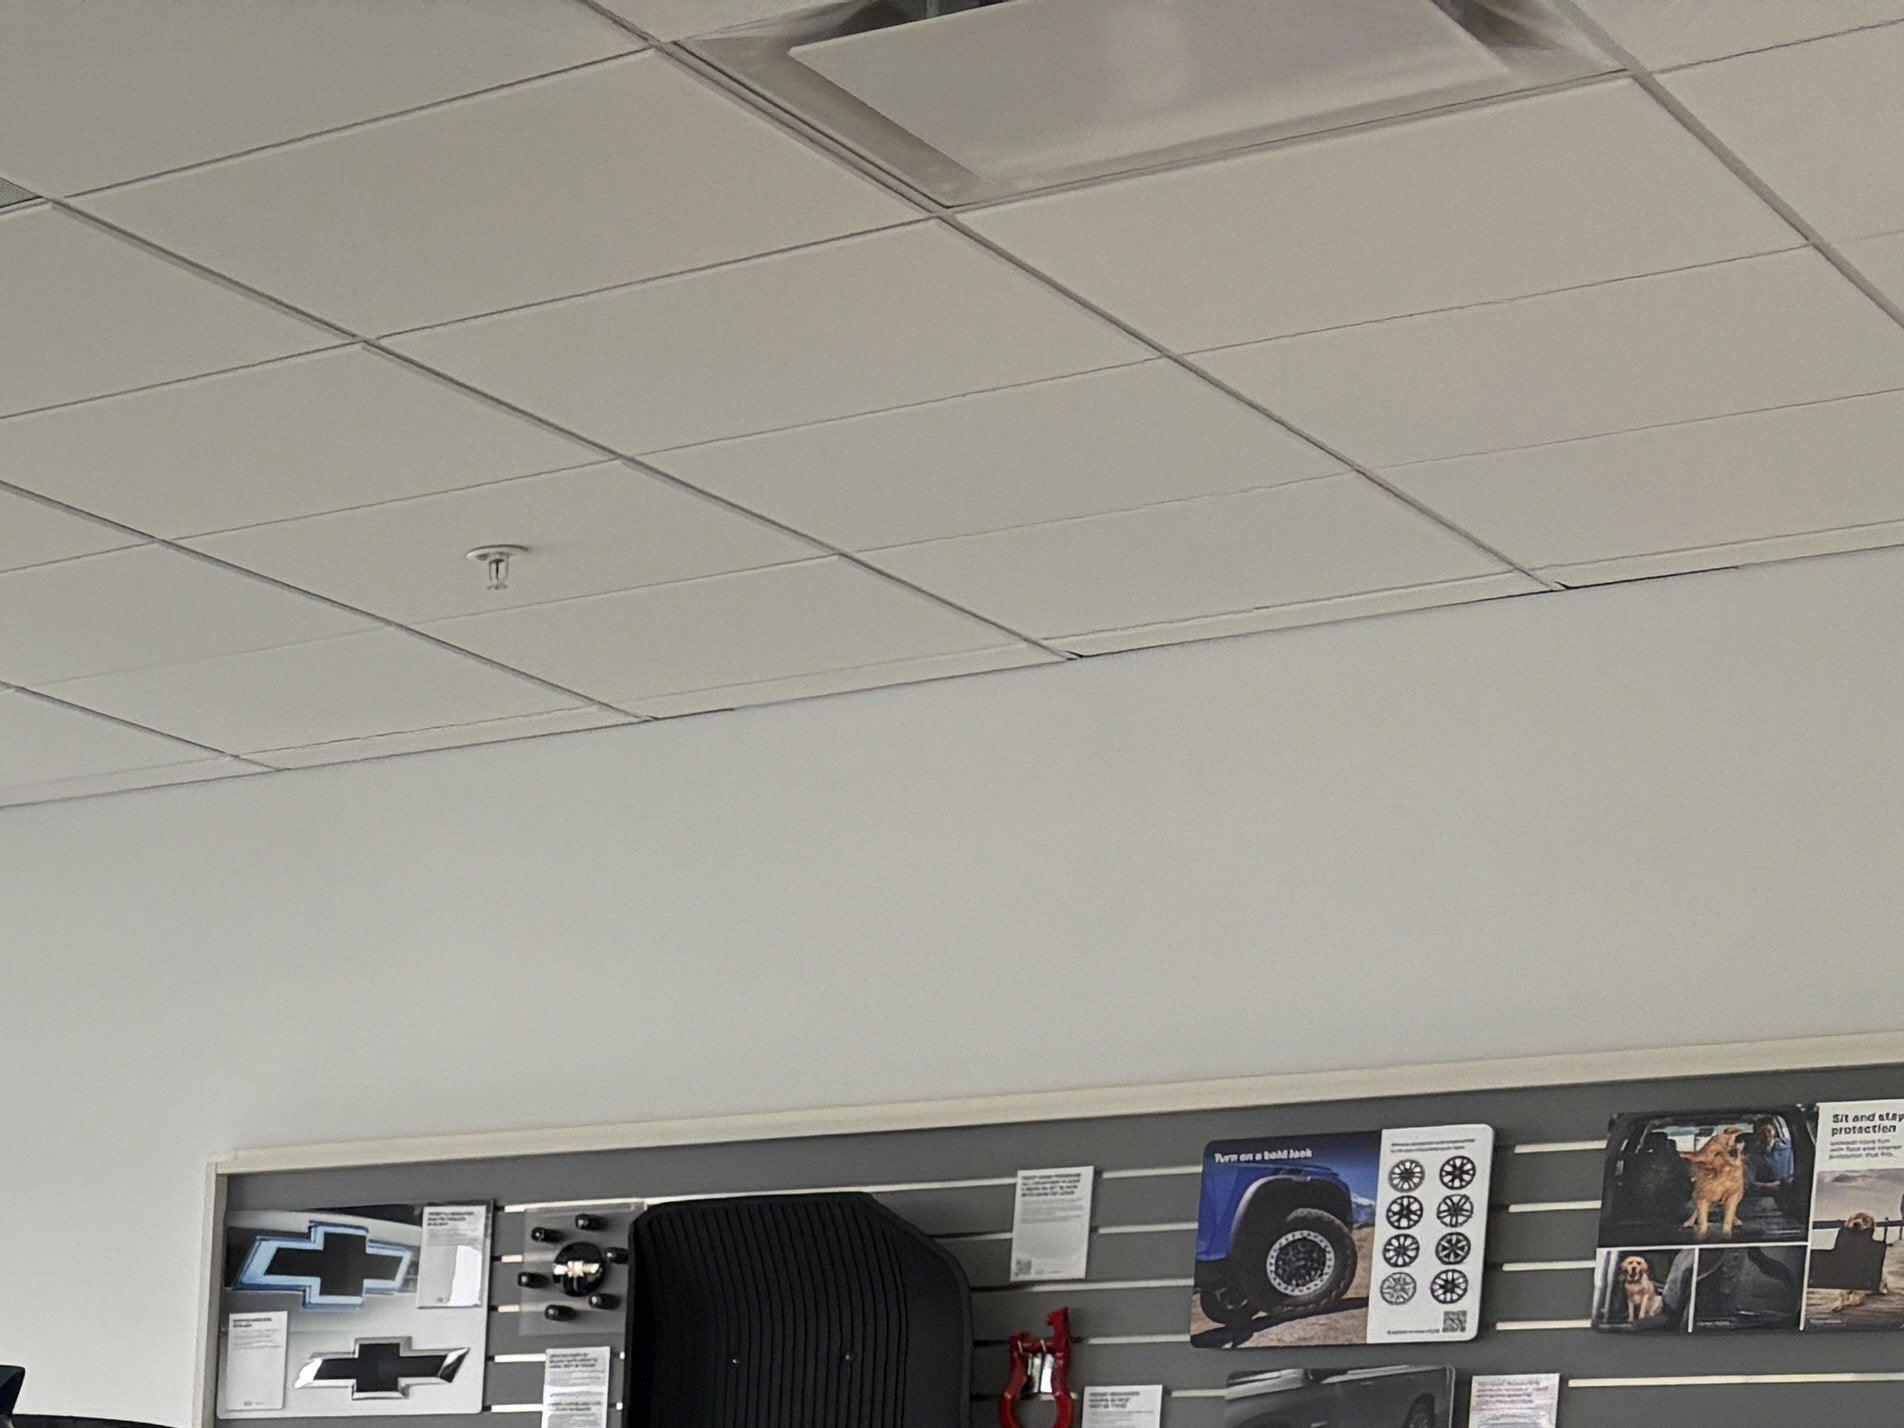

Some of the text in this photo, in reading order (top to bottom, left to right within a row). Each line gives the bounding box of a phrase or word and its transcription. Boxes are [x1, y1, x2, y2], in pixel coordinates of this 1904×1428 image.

[1832, 1113, 1849, 1123] Sit
[1852, 1112, 1876, 1122] and
[1831, 1123, 1897, 1137] protection
[1215, 1153, 1238, 1163] Turn
[1239, 1153, 1253, 1161] on
[1264, 1150, 1288, 1160] bold
[1289, 1148, 1312, 1159] look
